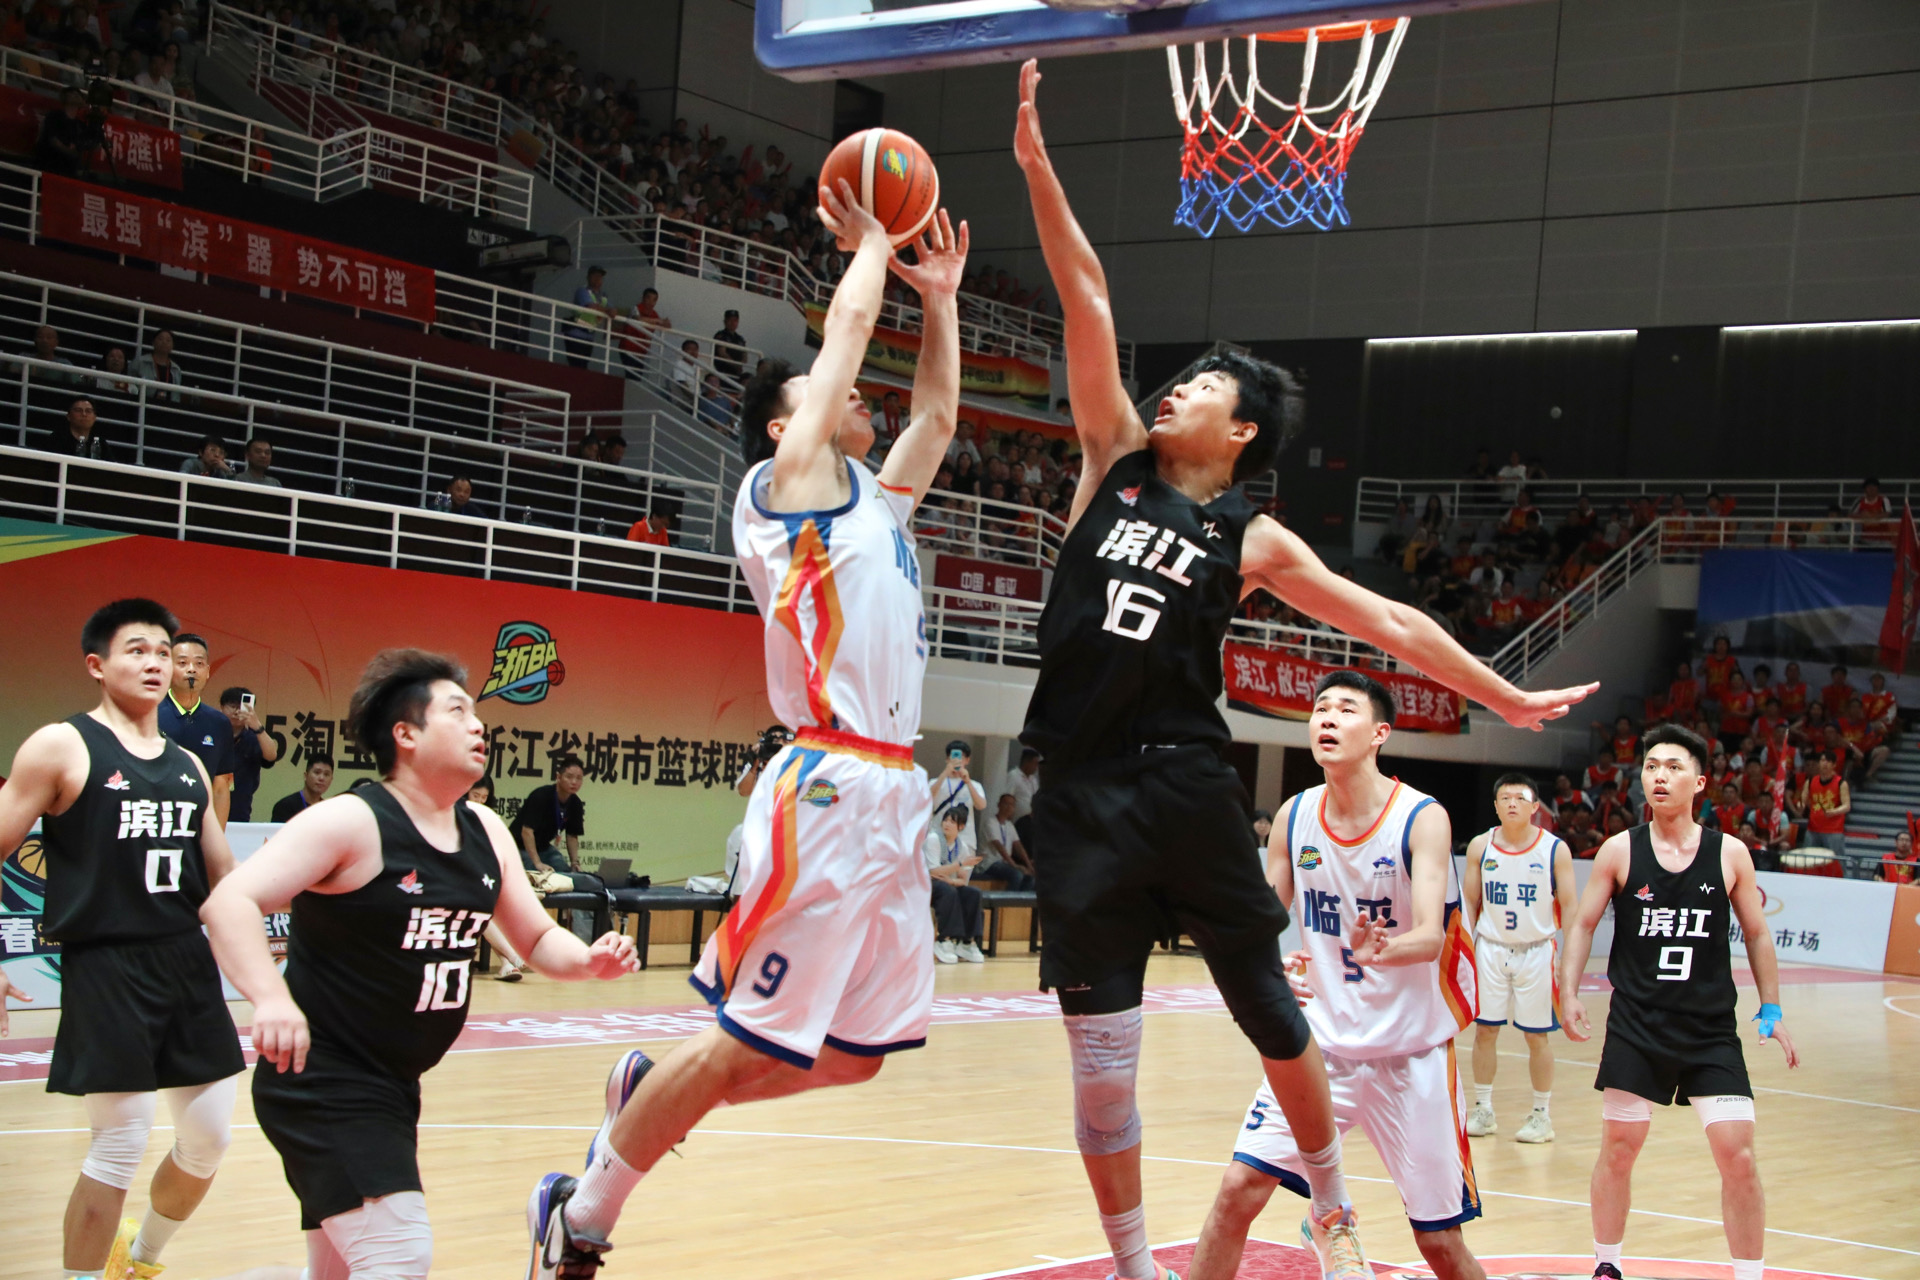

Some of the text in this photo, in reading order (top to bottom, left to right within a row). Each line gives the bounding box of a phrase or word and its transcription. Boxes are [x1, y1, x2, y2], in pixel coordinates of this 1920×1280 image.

[297, 246, 408, 308] 势不可挡
[1096, 518, 1208, 587] 滨江
[1101, 579, 1167, 641] 16
[117, 799, 198, 839] 滨江
[145, 849, 184, 894] 0
[1304, 887, 1398, 938] 临平
[1485, 881, 1538, 907] 临平
[400, 907, 493, 950] 滨江
[1505, 911, 1518, 930] 3
[1638, 907, 1712, 938] 滨江
[751, 949, 791, 1000] 9
[1340, 946, 1365, 984] 5
[1657, 946, 1694, 981] 9
[414, 959, 473, 1012] 10
[1245, 1099, 1272, 1131] 5
